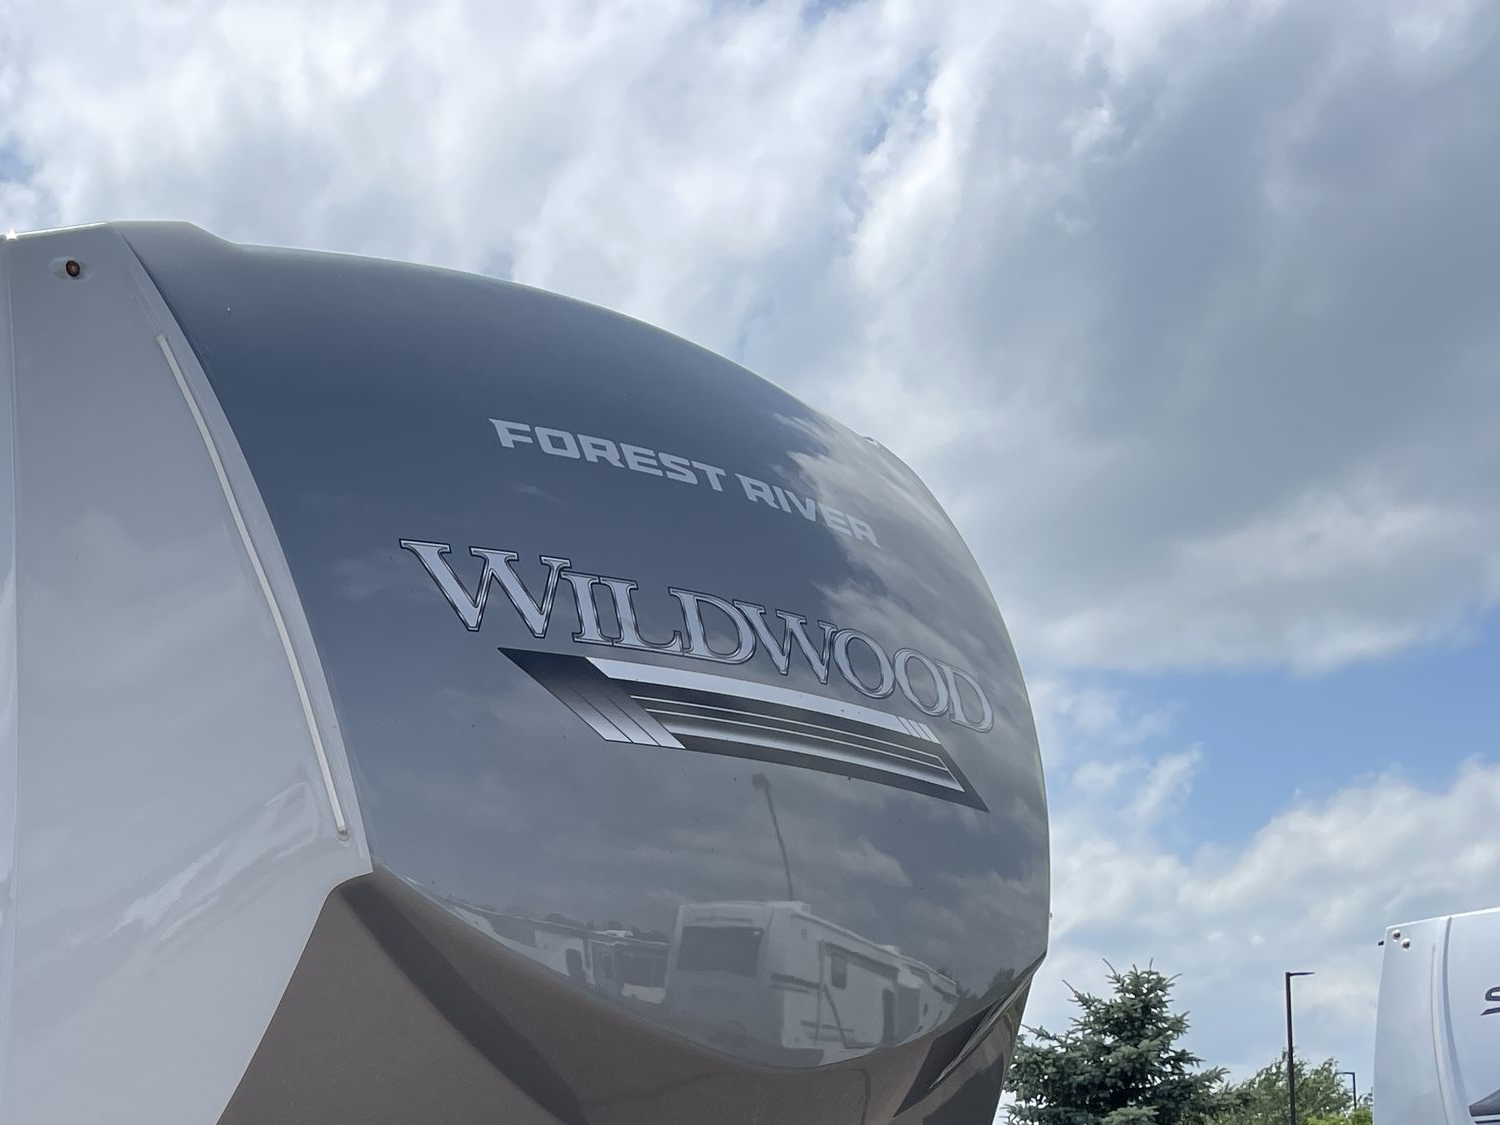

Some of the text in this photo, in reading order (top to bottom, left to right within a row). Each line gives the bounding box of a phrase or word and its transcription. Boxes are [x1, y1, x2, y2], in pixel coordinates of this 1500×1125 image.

[488, 417, 881, 548] FOREST RIVER
[399, 538, 993, 732] WILDWOOD
